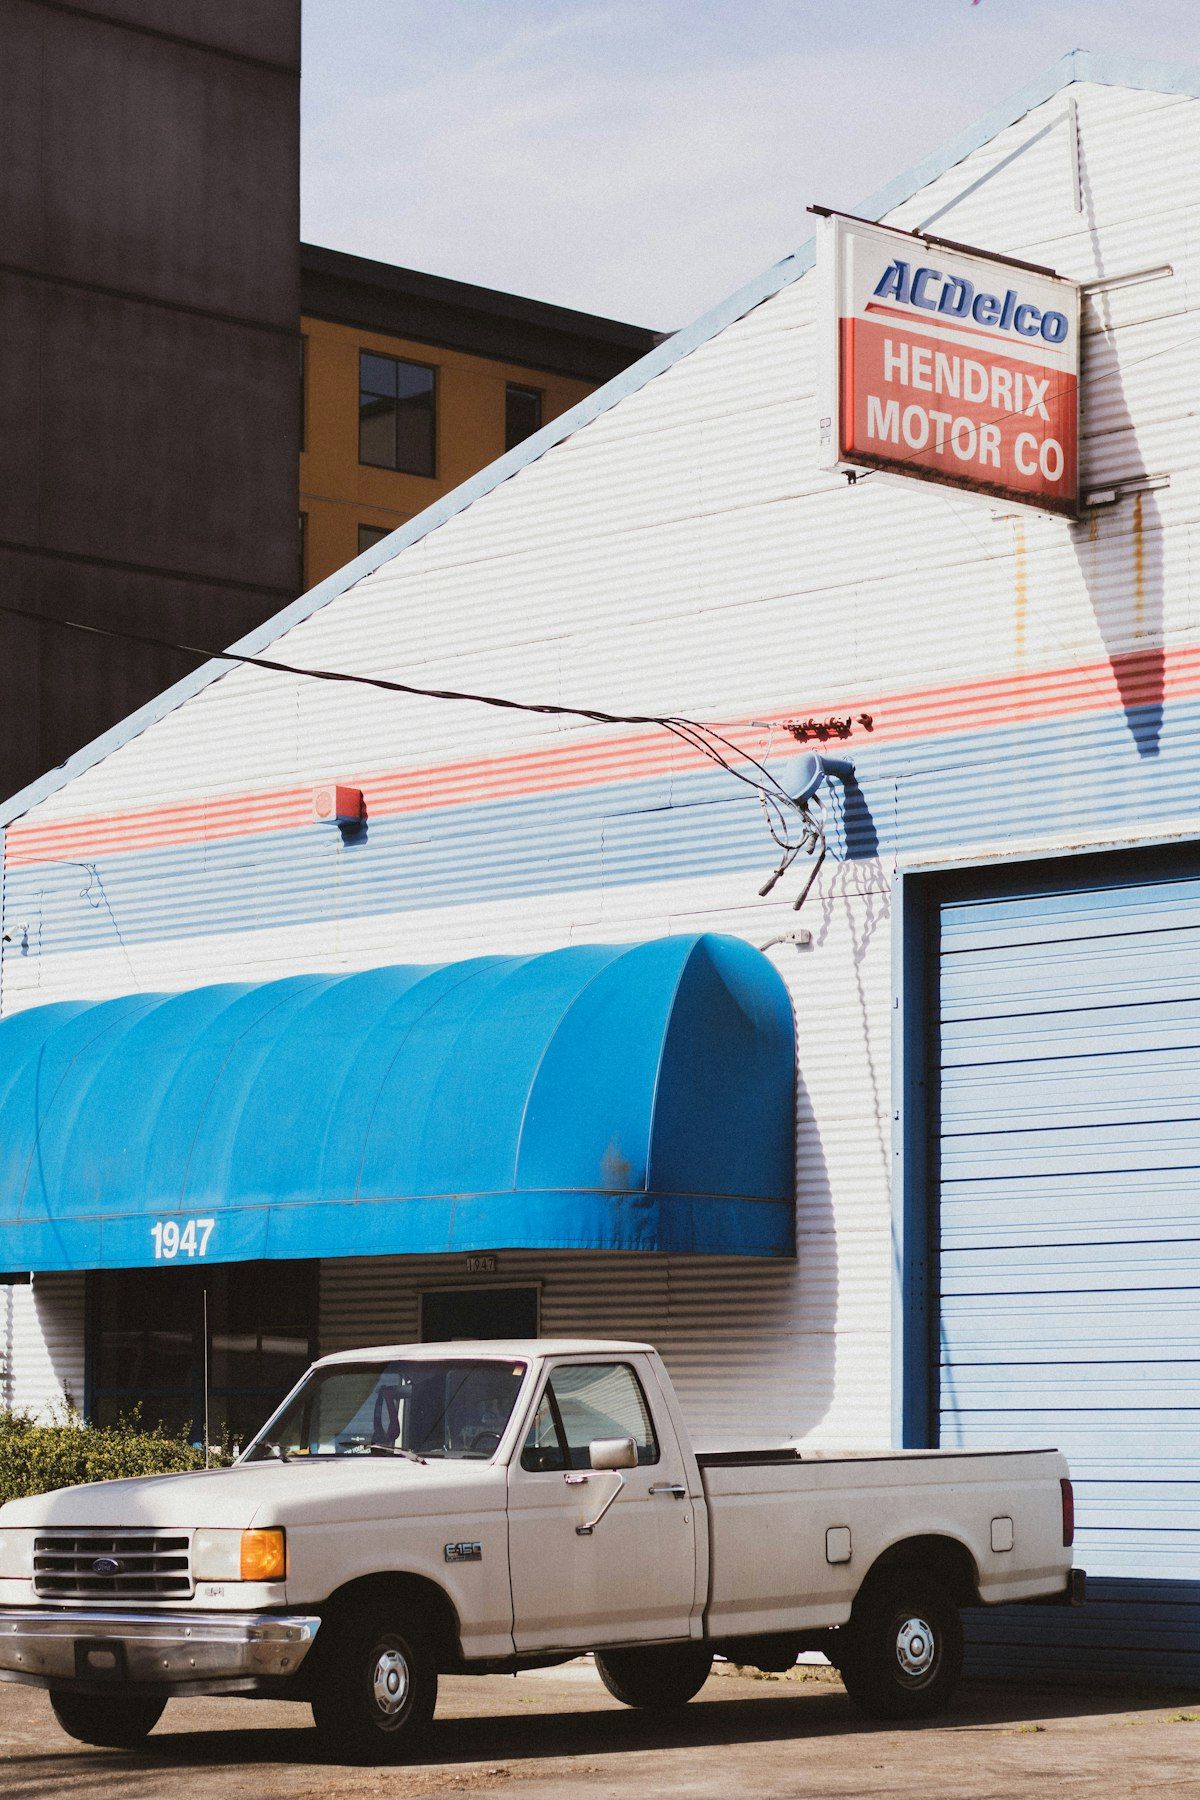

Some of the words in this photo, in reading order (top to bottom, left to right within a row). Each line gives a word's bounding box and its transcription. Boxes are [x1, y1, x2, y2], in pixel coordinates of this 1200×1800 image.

[873, 258, 1069, 343] ACDelco
[883, 339, 1051, 422] HENDRIX
[866, 395, 1002, 468] MOTOR
[1014, 432, 1065, 482] CO
[151, 1218, 215, 1259] 1947
[467, 1257, 496, 1272] 1947
